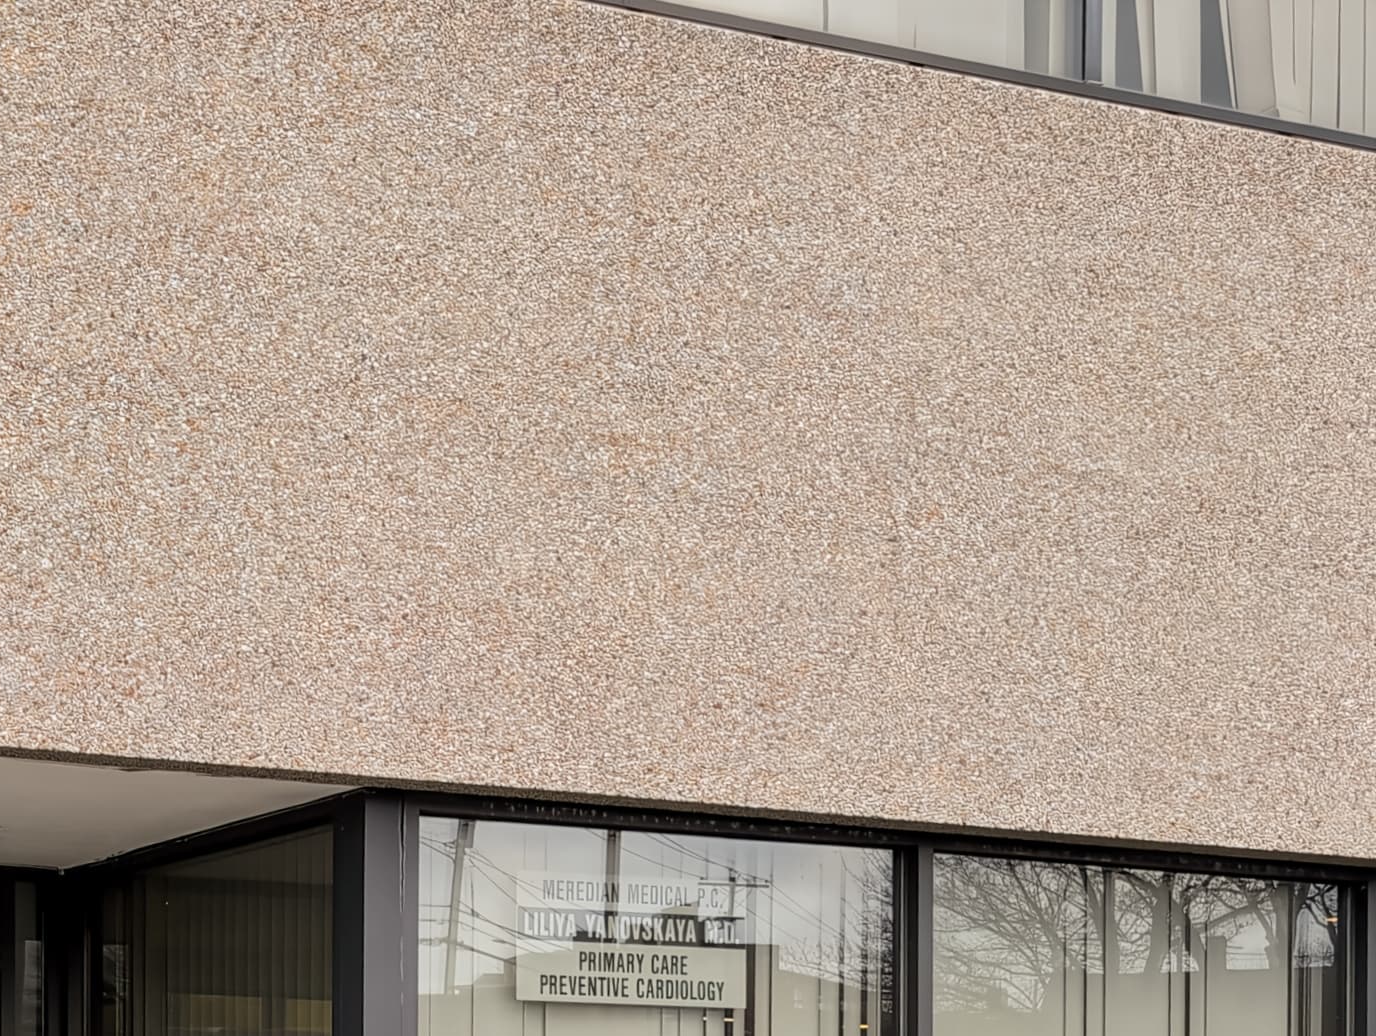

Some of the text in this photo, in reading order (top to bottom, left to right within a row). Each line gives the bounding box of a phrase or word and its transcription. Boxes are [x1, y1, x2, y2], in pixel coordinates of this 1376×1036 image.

[542, 879, 724, 908] MEREDIAN MEDICAL P.C.
[524, 912, 740, 945] LILIYA YANOVSKAYA M.D.
[579, 951, 688, 976] PRIMARY CARE
[540, 974, 725, 1001] PREVENTIVE CARDIOLOGY
